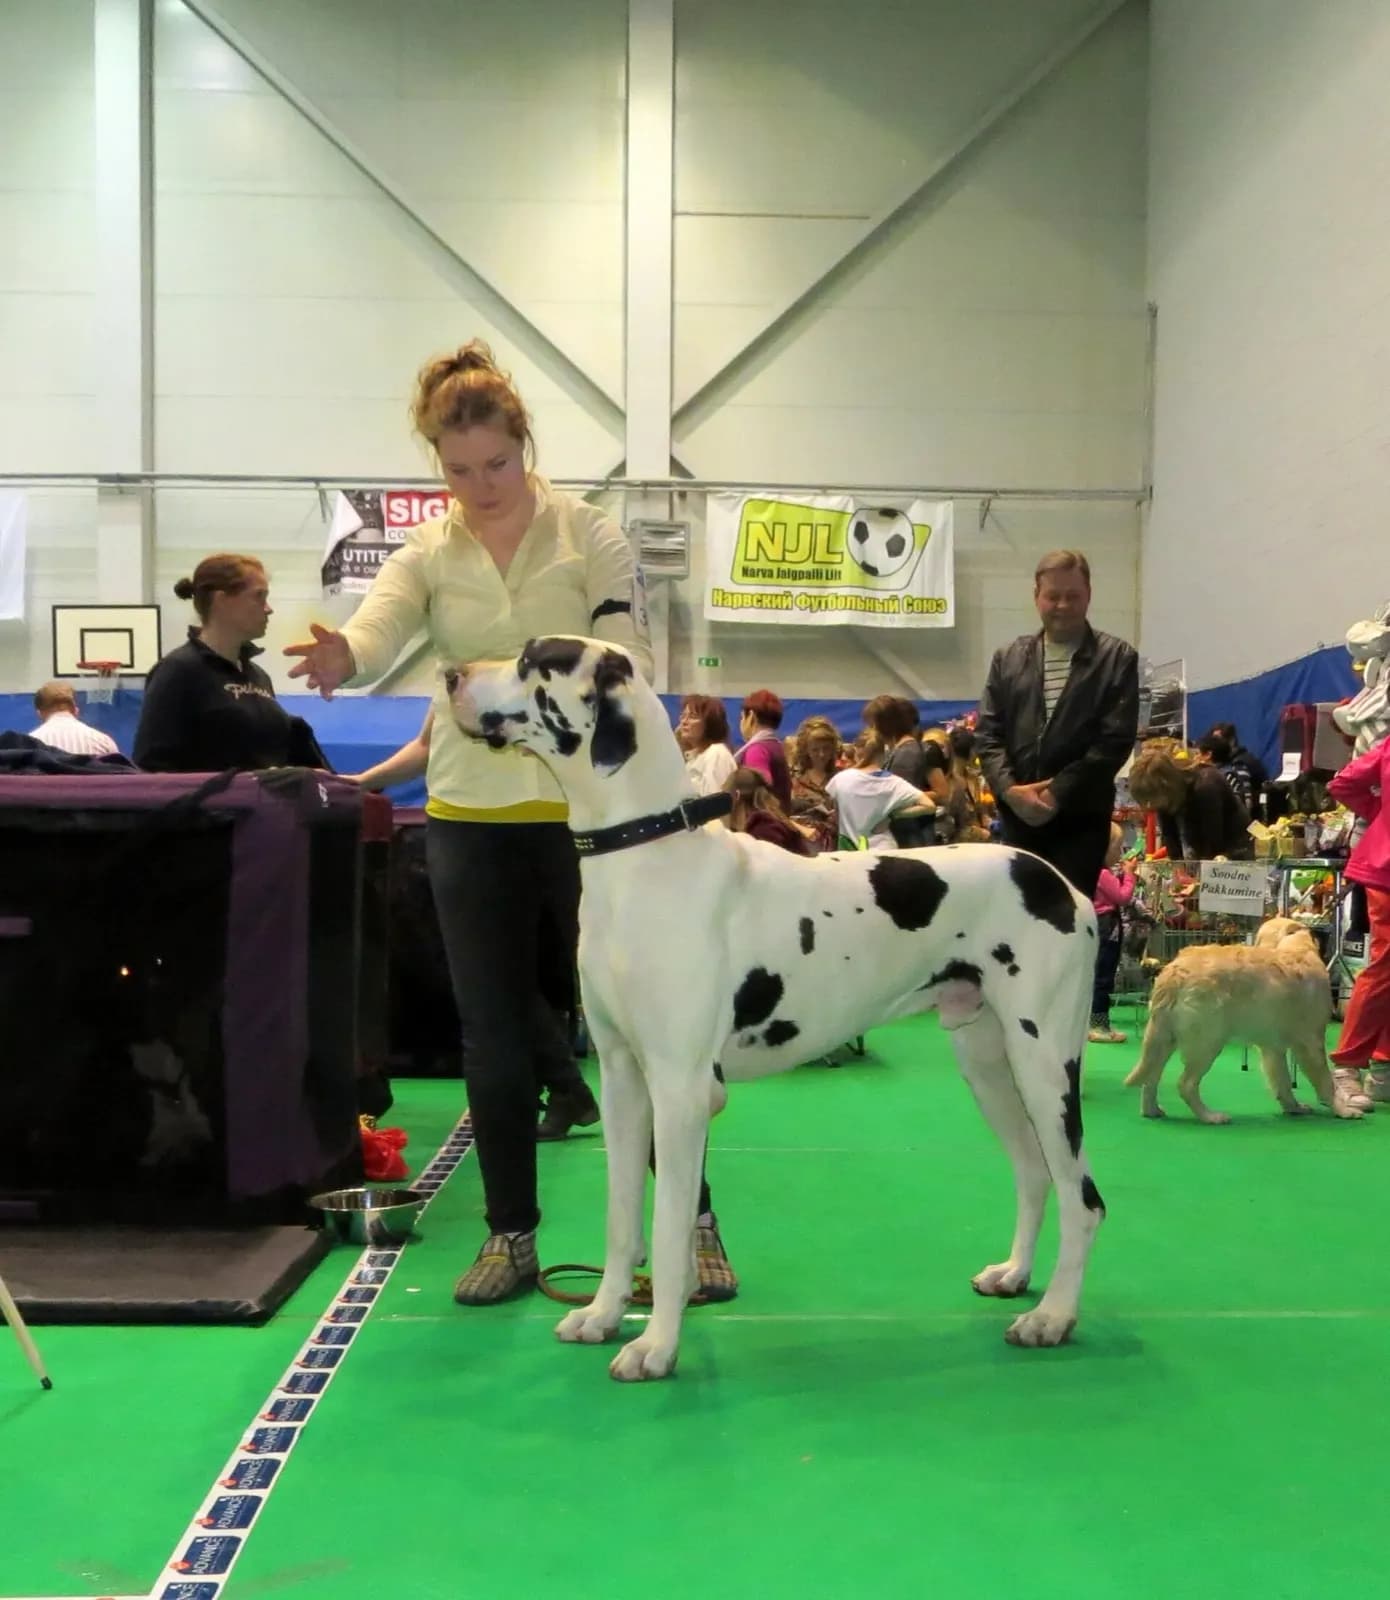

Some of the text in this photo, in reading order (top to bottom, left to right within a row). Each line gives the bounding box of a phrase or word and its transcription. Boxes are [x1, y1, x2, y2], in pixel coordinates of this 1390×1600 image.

[744, 520, 844, 565] NJL
[742, 566, 774, 578] Narva
[712, 588, 947, 614] Нарвский Футбольный Союз
[1210, 867, 1251, 881] Soodne
[1201, 882, 1262, 898] Pakkumine
[192, 1537, 223, 1574] ADVANCE
